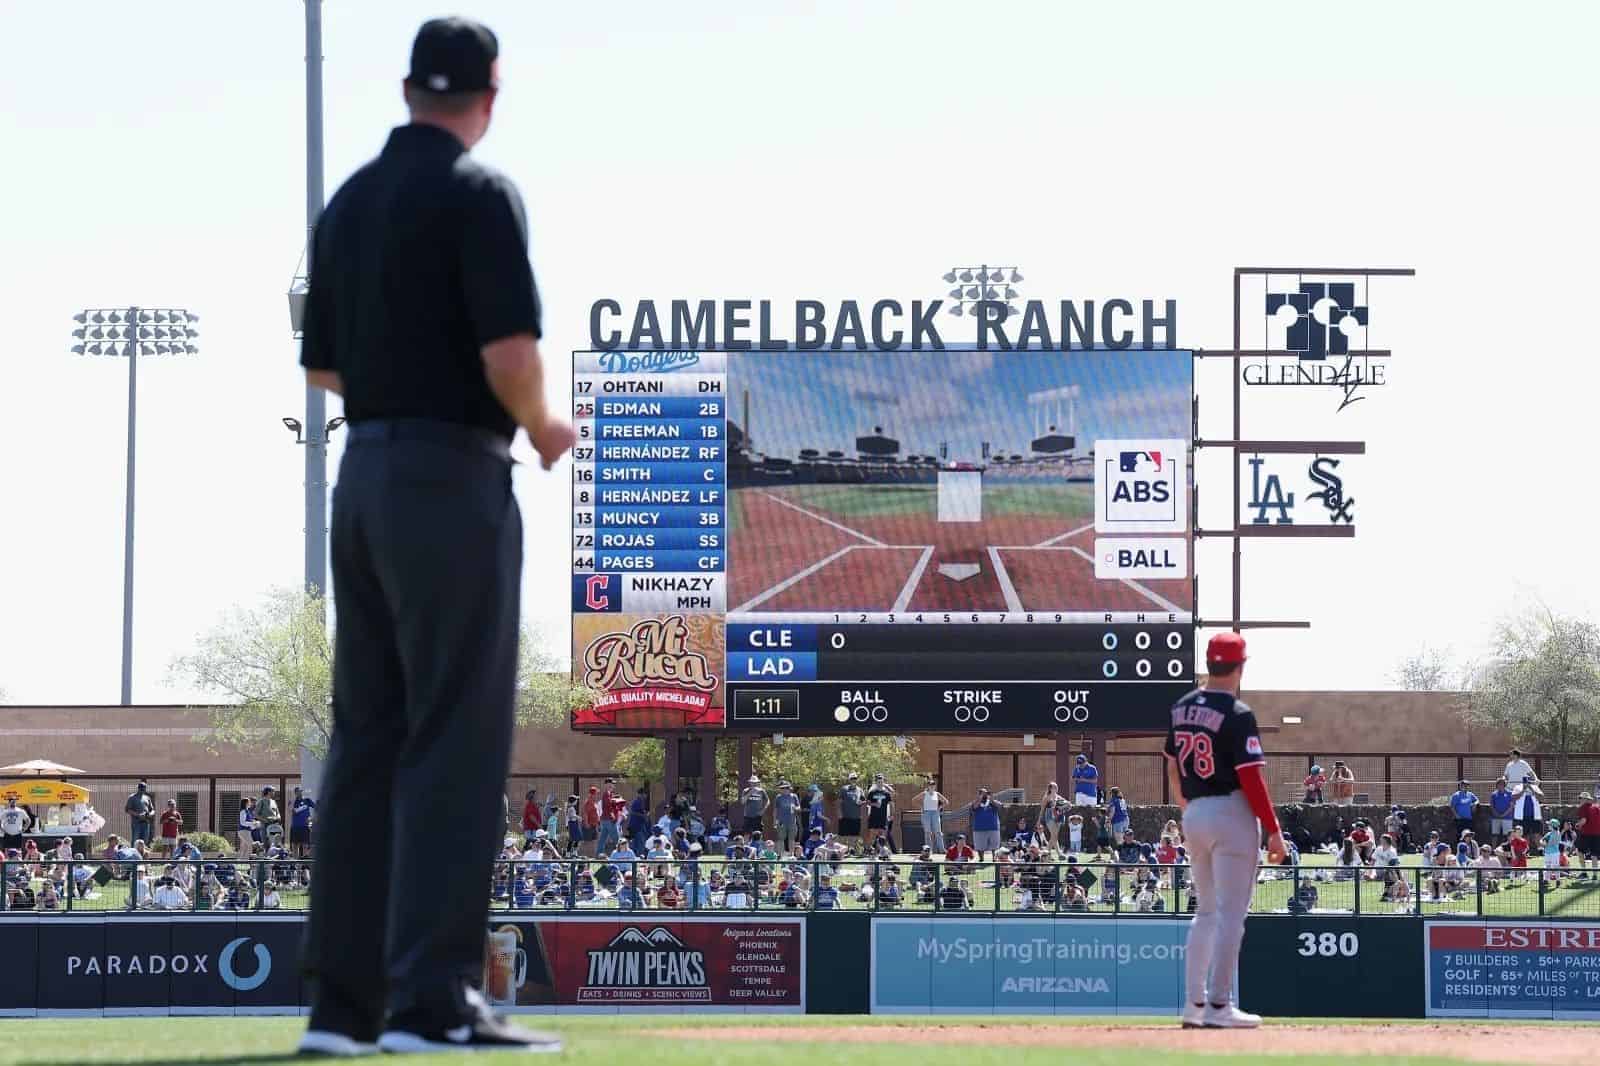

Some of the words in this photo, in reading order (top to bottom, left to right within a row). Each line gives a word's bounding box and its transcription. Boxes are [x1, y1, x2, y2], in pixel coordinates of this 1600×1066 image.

[590, 298, 945, 350] CAMELBACK
[977, 298, 1176, 350] RANCH
[1242, 354, 1386, 388] GLENDALE
[577, 382, 593, 393] 17
[602, 381, 663, 393] OHTANI
[698, 381, 721, 393] DH
[576, 404, 593, 415] 25
[603, 403, 661, 415] EDMAN
[699, 403, 719, 415] 2B
[580, 426, 589, 437] 5
[603, 426, 680, 437] FREEMAN
[701, 426, 718, 437] 1B
[576, 447, 593, 459] 37
[603, 444, 690, 459] HERNÁNDEZ
[699, 447, 719, 459] RF
[577, 470, 592, 481] 16
[602, 468, 650, 480] SMITH
[703, 469, 714, 481] C
[580, 492, 589, 503] 8
[602, 488, 690, 503] HERNÁNDEZ
[700, 491, 718, 502] LF
[1112, 480, 1169, 503] ABS
[577, 513, 592, 524] 13
[602, 513, 660, 524] MUNCY
[699, 513, 719, 525] 3B
[576, 535, 593, 547] 72
[602, 535, 655, 547] ROJAS
[699, 535, 718, 547] SS
[575, 557, 594, 568] 44
[602, 557, 654, 568] PAGES
[699, 557, 719, 568] CF
[1118, 549, 1176, 568] BALL
[632, 578, 713, 591] NIKHAZY
[586, 575, 609, 610] C
[677, 597, 711, 608] MPH
[834, 614, 839, 623] 1
[860, 614, 867, 623] 2
[888, 614, 895, 623] 3
[915, 614, 923, 623] 4
[943, 614, 950, 623] 5
[971, 614, 978, 623] 6
[999, 614, 1006, 623] 7
[1026, 614, 1034, 623] 8
[1055, 614, 1062, 623] 9
[1105, 614, 1112, 623] R
[1137, 614, 1145, 623] H
[1168, 614, 1175, 623] E
[631, 615, 689, 656] Mi
[750, 630, 792, 647] CLE
[831, 633, 845, 648] 0
[1102, 632, 1118, 650] 0
[1135, 632, 1150, 649] 0
[1166, 632, 1182, 649] 0
[748, 658, 794, 675] LAD
[1102, 660, 1118, 677] 0
[1136, 659, 1151, 677] 0
[1167, 659, 1183, 677] 0
[621, 692, 653, 703] QUALITY
[656, 692, 705, 706] MICHELADAS
[841, 691, 884, 703] BALL
[943, 690, 1002, 703] STRIKE
[1054, 690, 1090, 703] OUT
[753, 699, 781, 714] 1:11
[1174, 731, 1215, 778] 78
[1298, 932, 1359, 956] 380
[736, 953, 781, 961] GLENDALE
[917, 938, 1190, 964] MySpringTraining.com
[67, 955, 208, 975] PARADOX
[1443, 955, 1451, 966] 7
[1455, 955, 1519, 966] BUILDERS
[1565, 956, 1600, 968] PARK
[588, 952, 639, 985] TWIN
[645, 952, 705, 985] PEAKS
[744, 977, 771, 985] TEMPE
[1444, 969, 1480, 981] GOLF
[1501, 970, 1523, 981] 65+
[1527, 971, 1566, 982] MILES
[1001, 977, 1110, 993] ARIZONA
[1525, 985, 1566, 997] CLUBS
[583, 990, 602, 998] EATS
[613, 990, 642, 998] DRINKS
[681, 990, 707, 998] VIEWS
[729, 989, 752, 997] DEER
[754, 989, 787, 997] VALLEY
